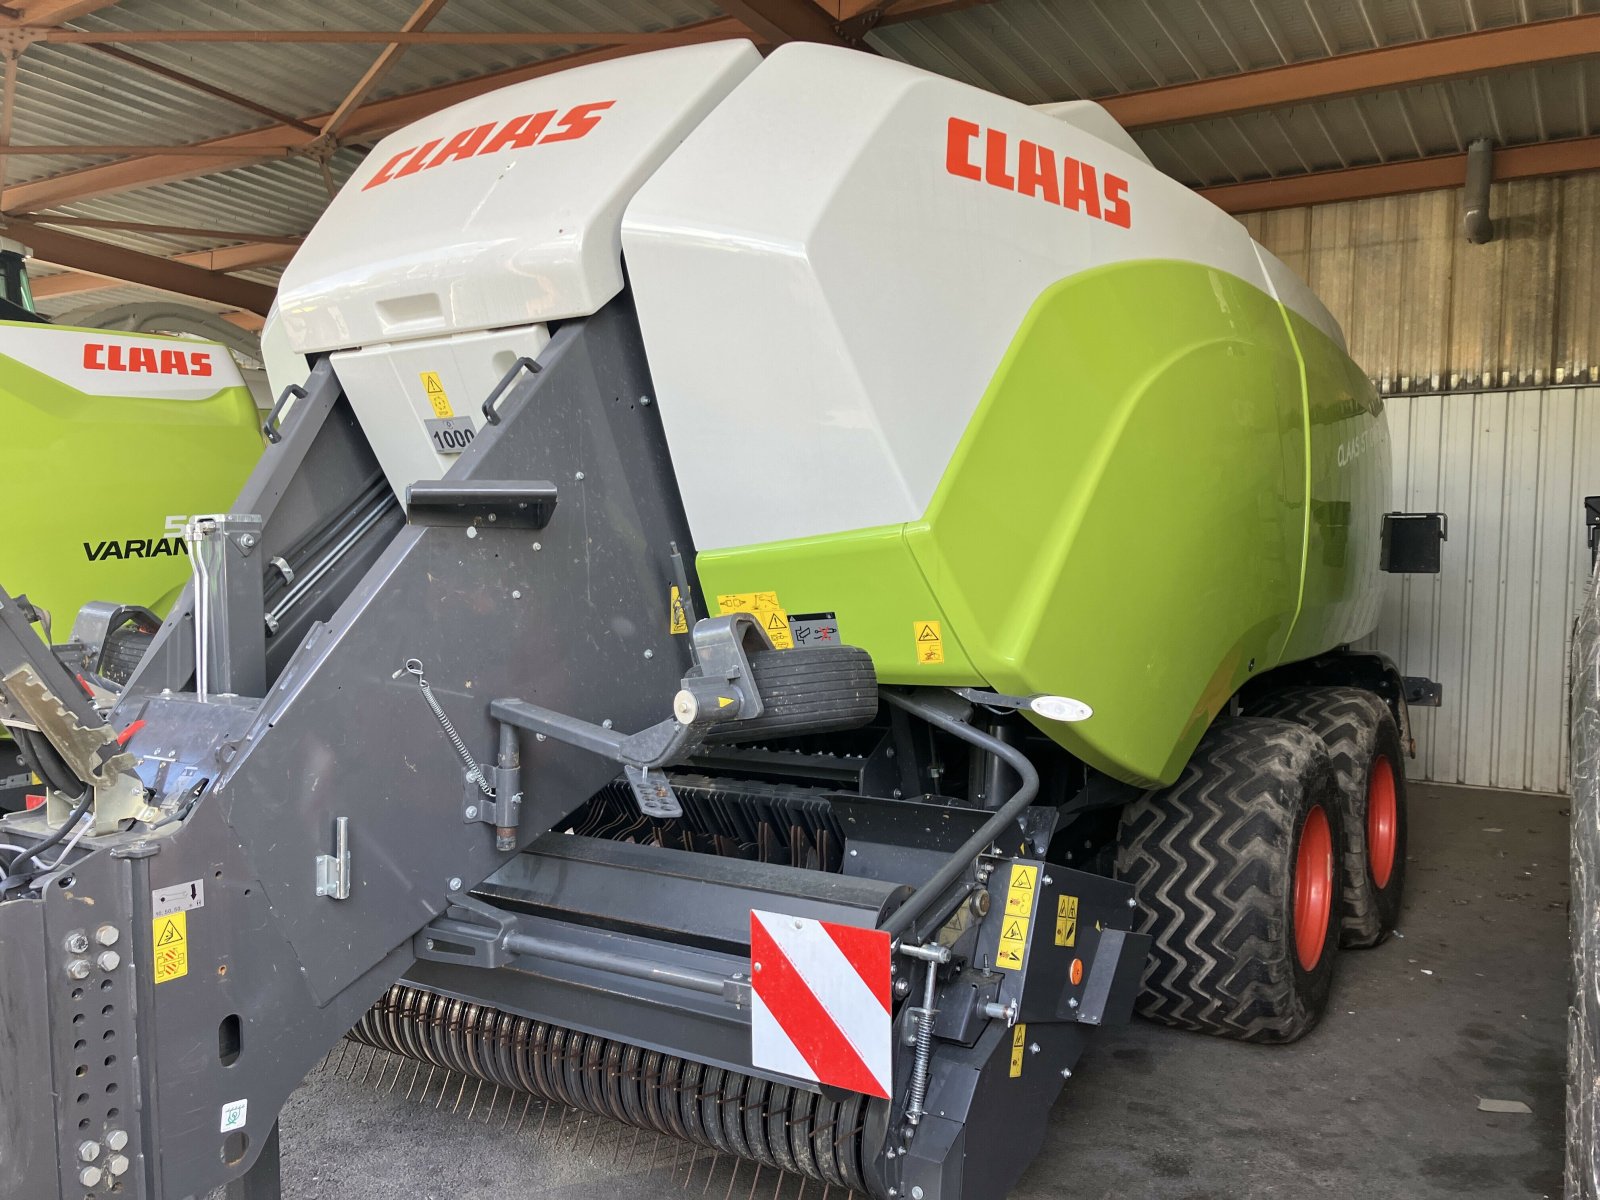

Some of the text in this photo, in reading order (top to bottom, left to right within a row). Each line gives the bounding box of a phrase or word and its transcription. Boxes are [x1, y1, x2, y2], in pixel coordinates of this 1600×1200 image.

[361, 100, 617, 192] CLAAS
[946, 117, 1131, 229] CLAAS
[83, 343, 212, 377] CLAAS
[83, 537, 189, 561] VARIAN
